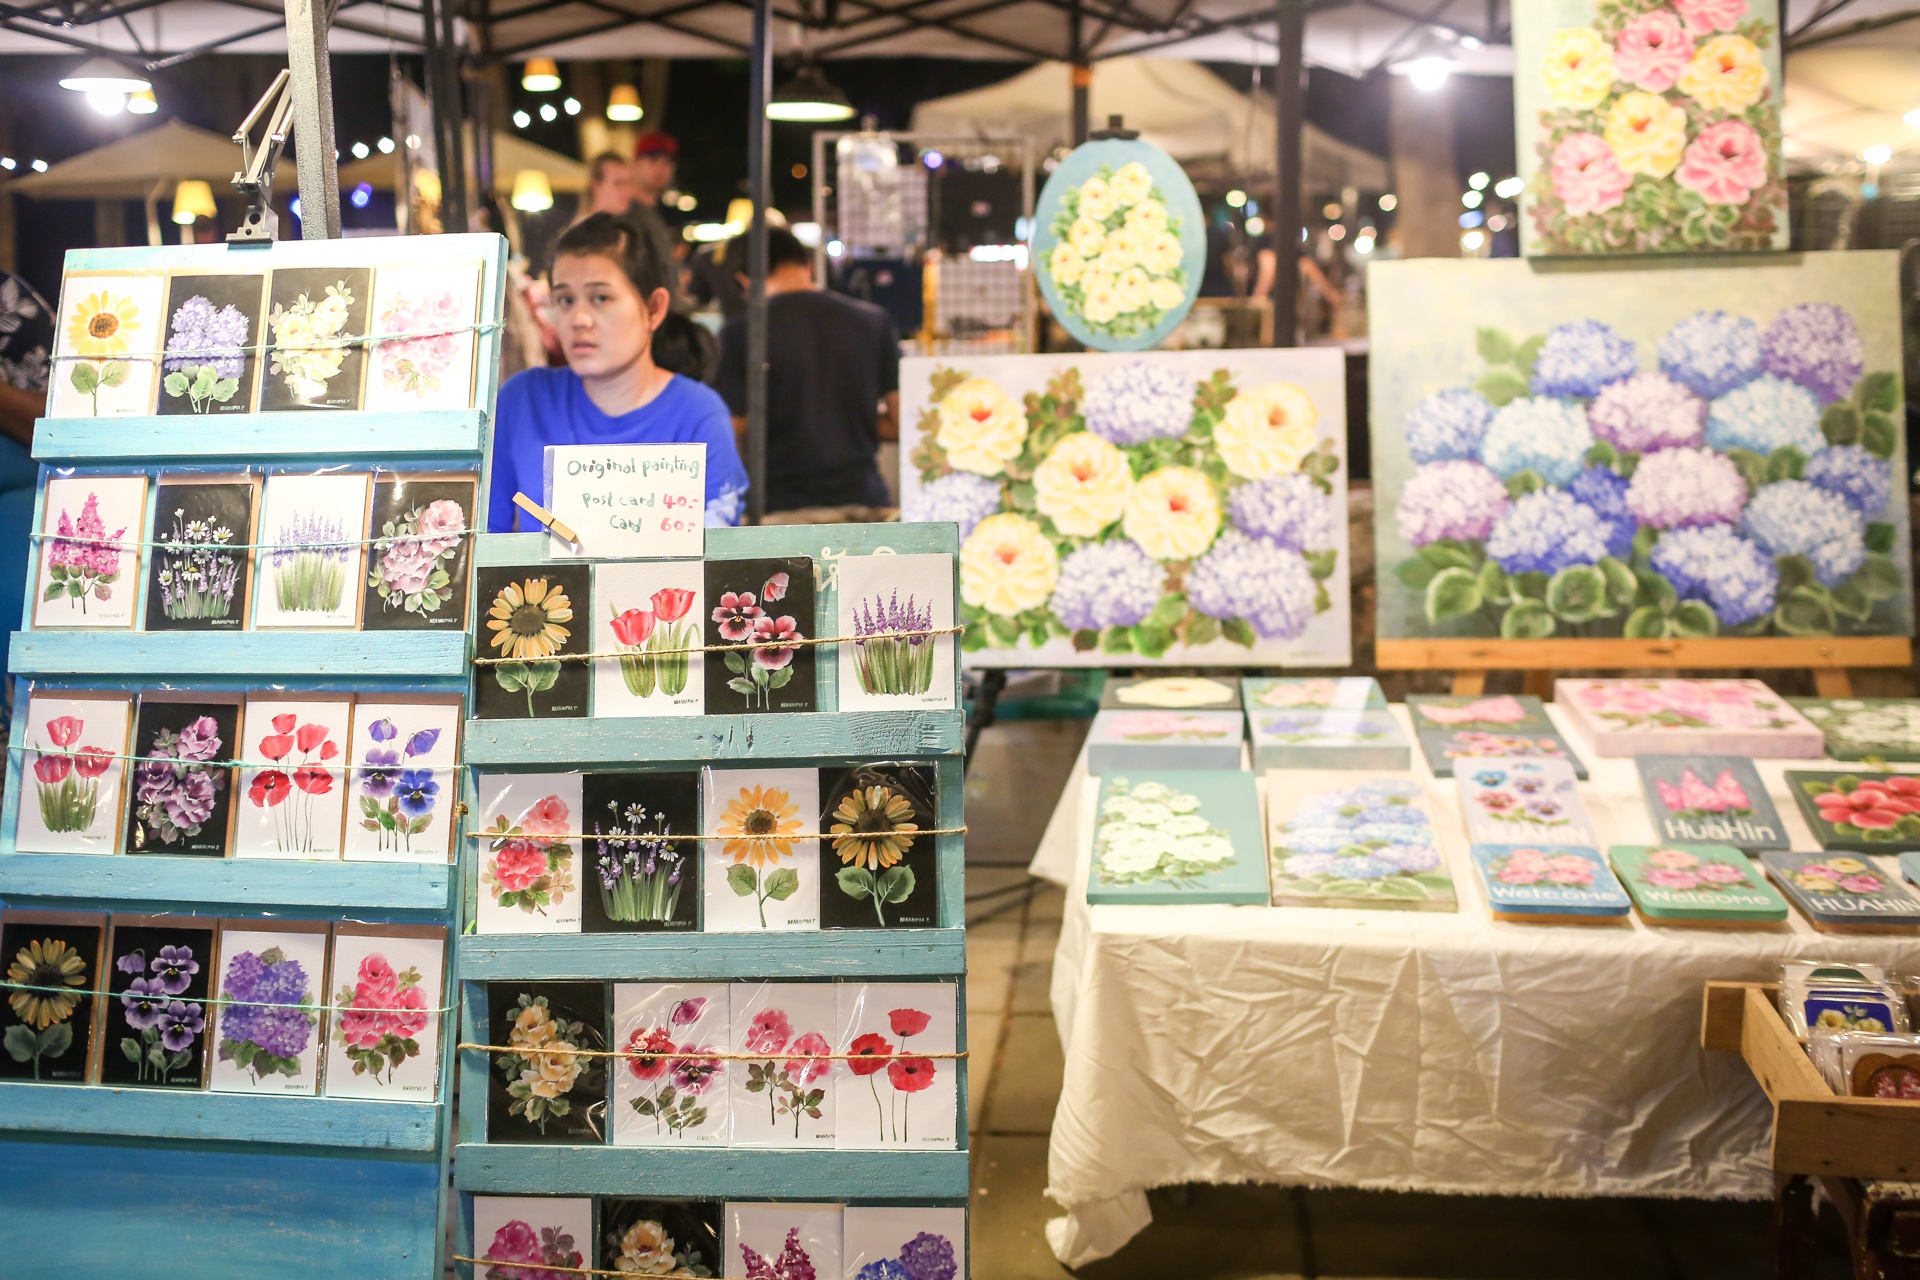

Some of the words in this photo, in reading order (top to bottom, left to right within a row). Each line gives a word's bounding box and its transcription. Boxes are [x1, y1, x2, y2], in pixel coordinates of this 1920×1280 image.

[567, 457, 636, 479] Original
[642, 455, 700, 480] painting
[619, 493, 655, 508] card
[609, 514, 643, 533] Card
